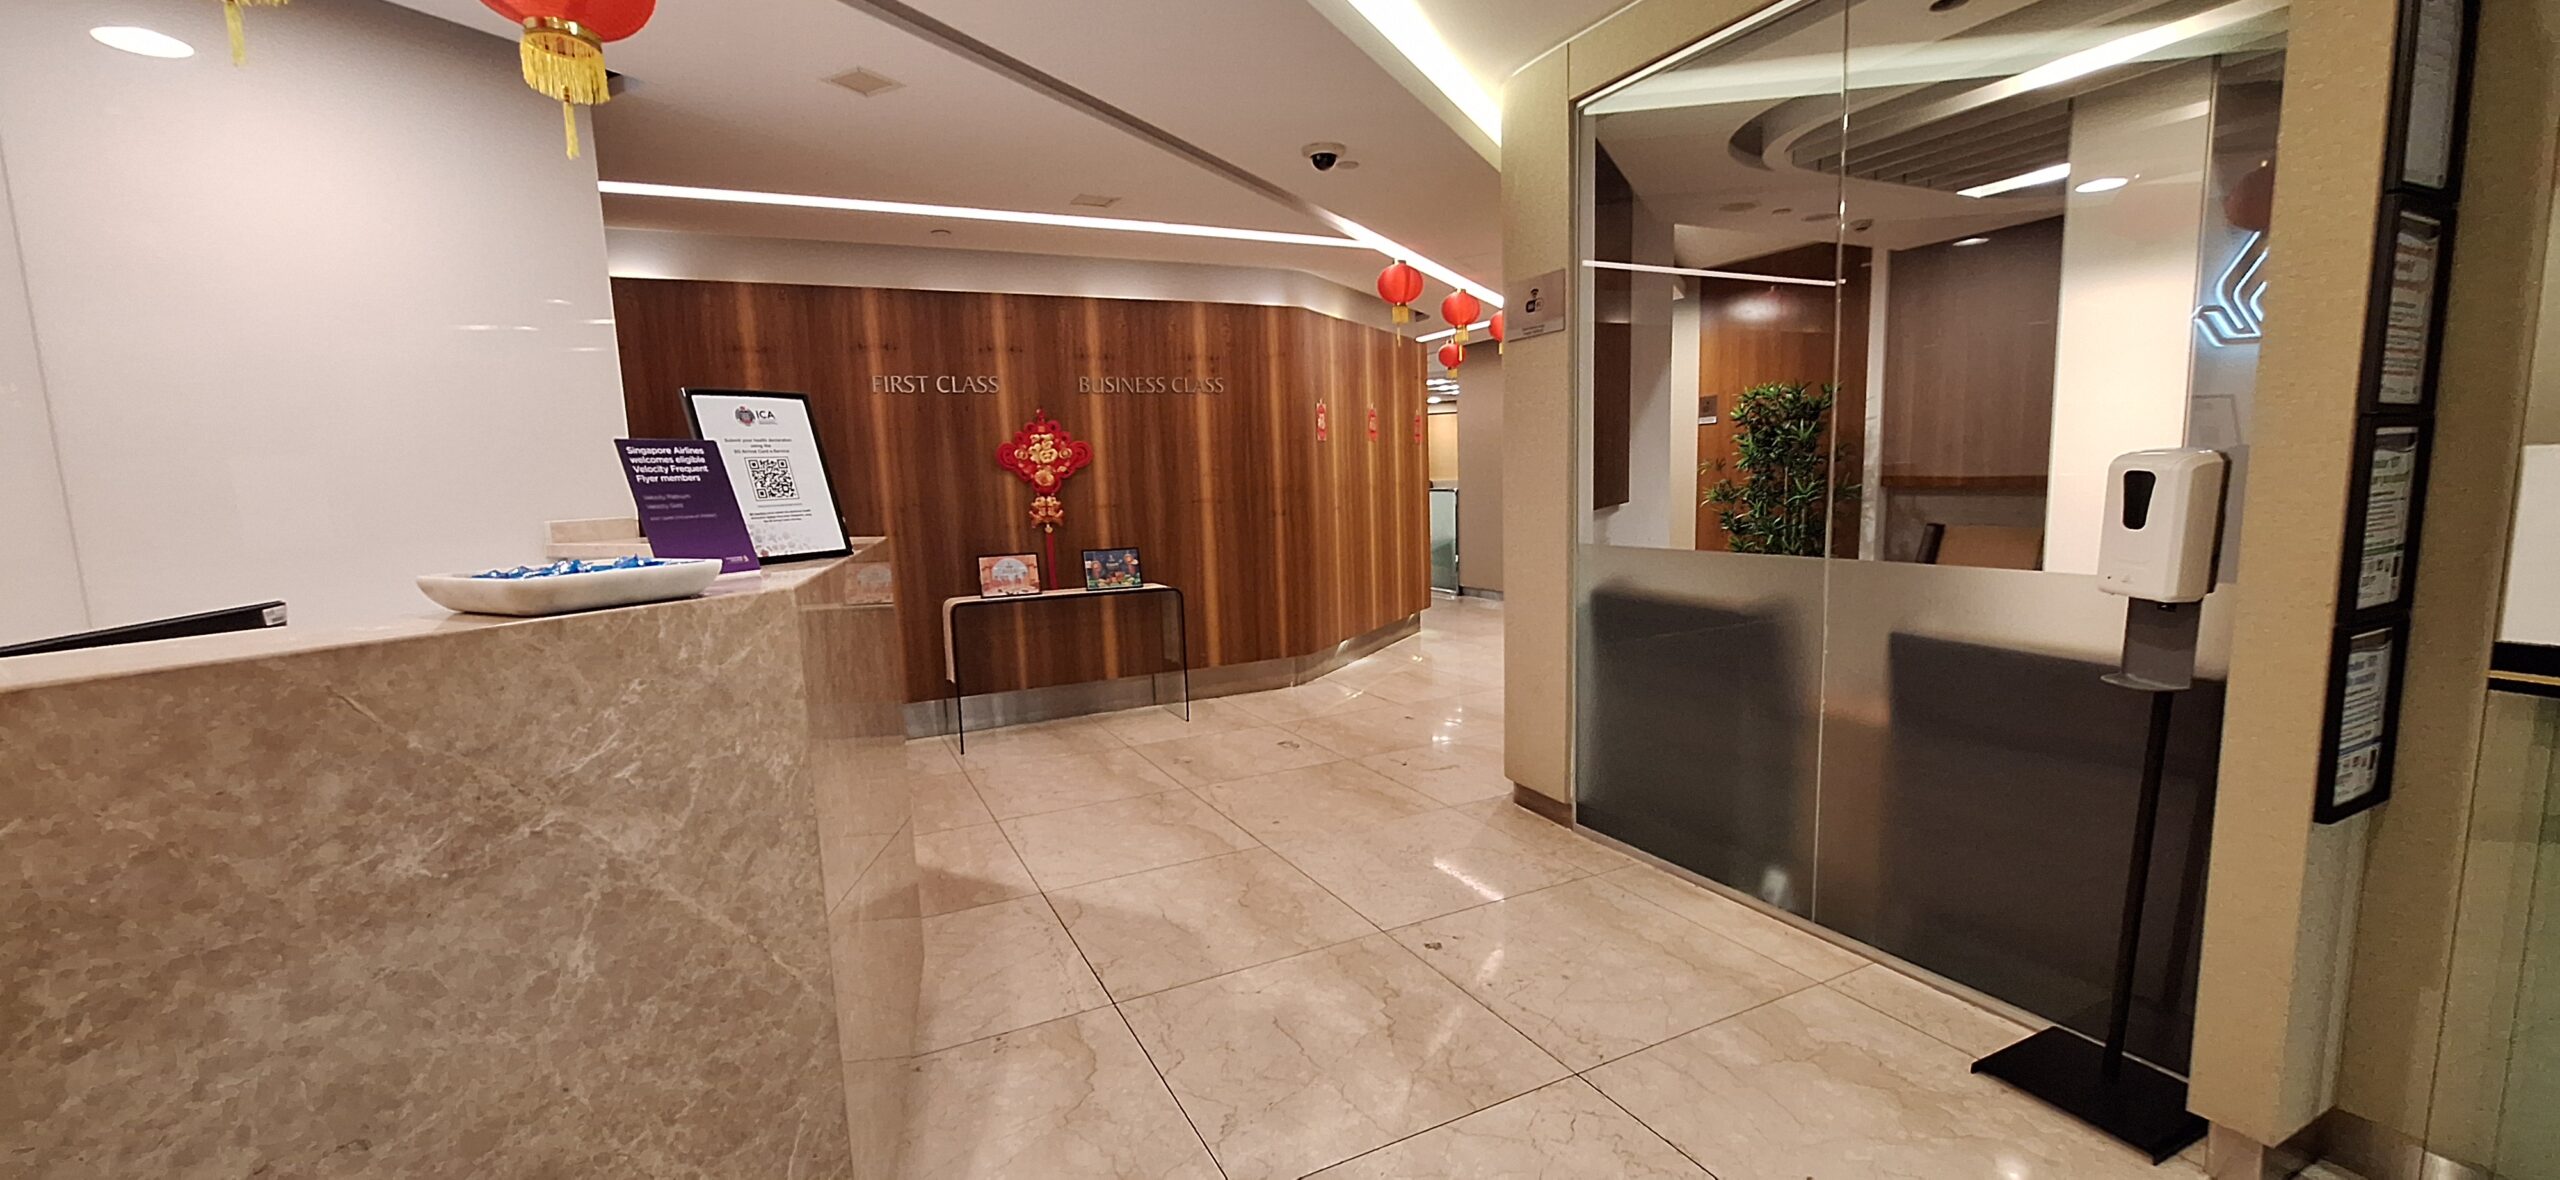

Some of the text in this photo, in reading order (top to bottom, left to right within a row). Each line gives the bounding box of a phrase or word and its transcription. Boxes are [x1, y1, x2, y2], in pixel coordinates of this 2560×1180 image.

[871, 375, 1000, 394] FIRST CLASS
[1079, 376, 1225, 393] BUSINESS CLASS
[755, 410, 776, 419] ICA
[625, 446, 704, 456] Singapore Airlines
[1028, 433, 1058, 464] 福
[629, 455, 706, 465] welcomes eligible
[632, 464, 709, 474] Velocity Frequent
[635, 473, 701, 484] Flyer members
